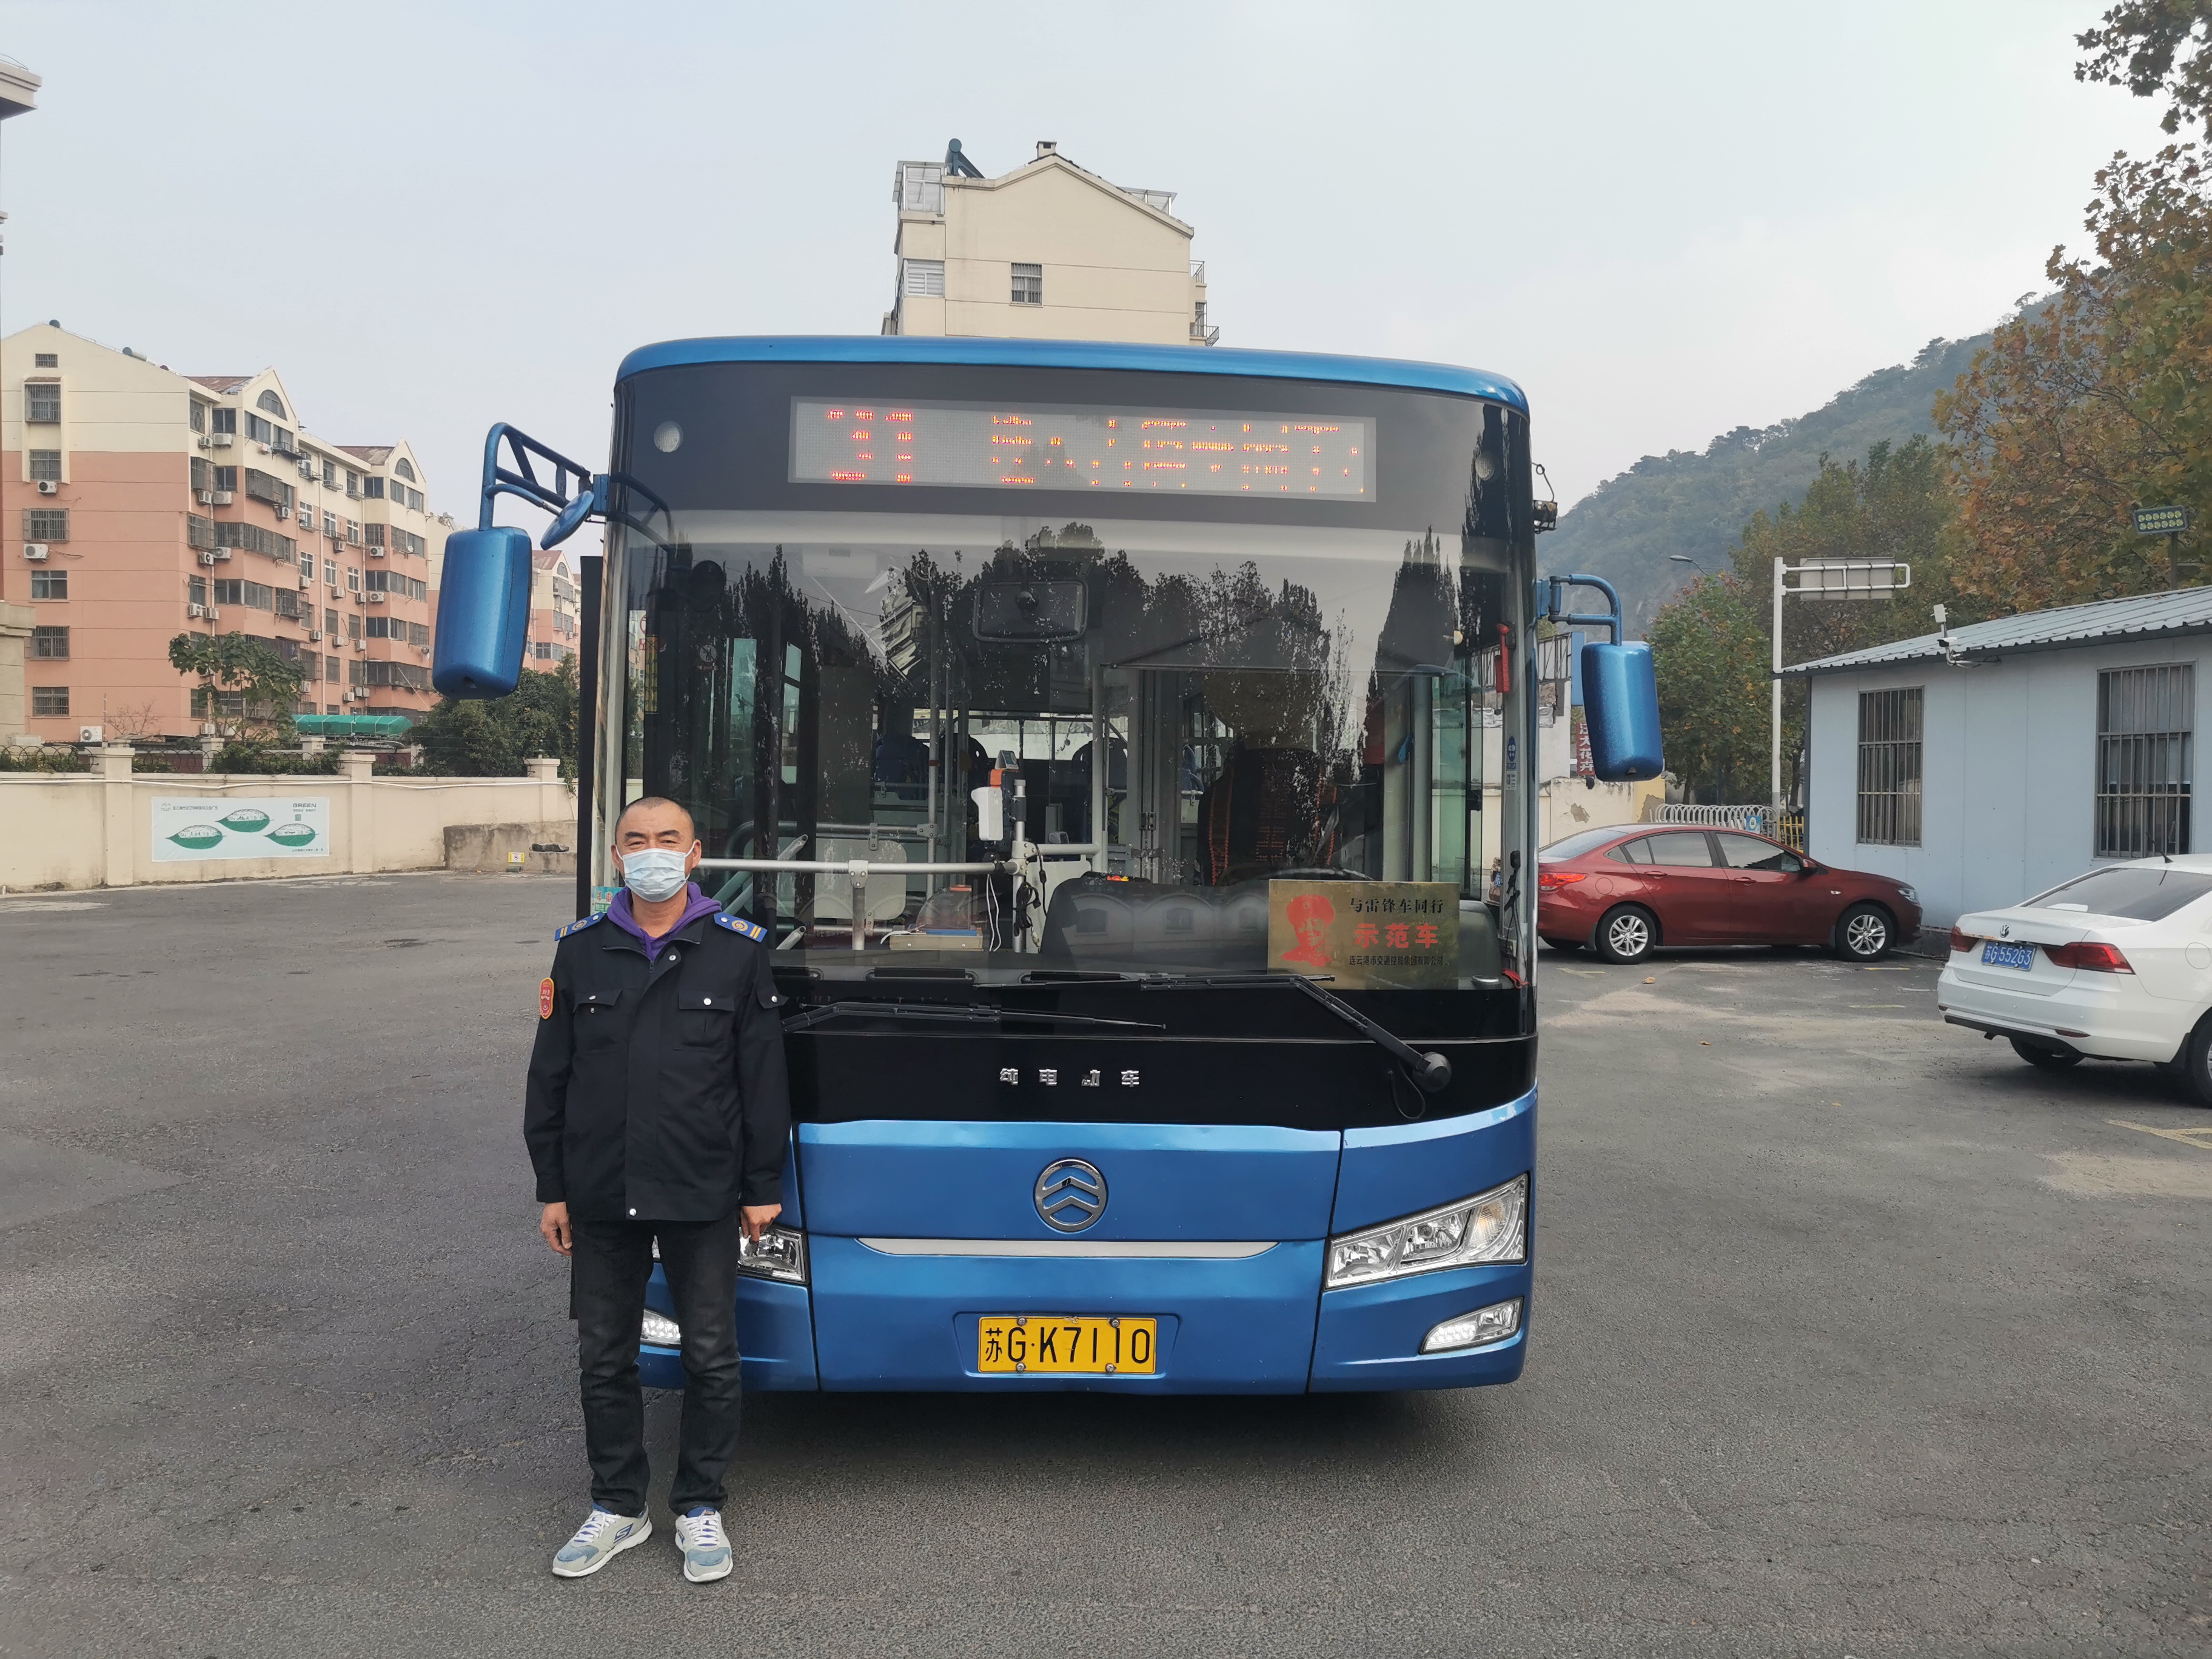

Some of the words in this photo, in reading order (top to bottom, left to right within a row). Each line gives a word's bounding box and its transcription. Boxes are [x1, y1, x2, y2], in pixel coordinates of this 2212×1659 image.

[1349, 897, 1444, 914] 与雷锋车同行
[1354, 922, 1439, 949] 示范车
